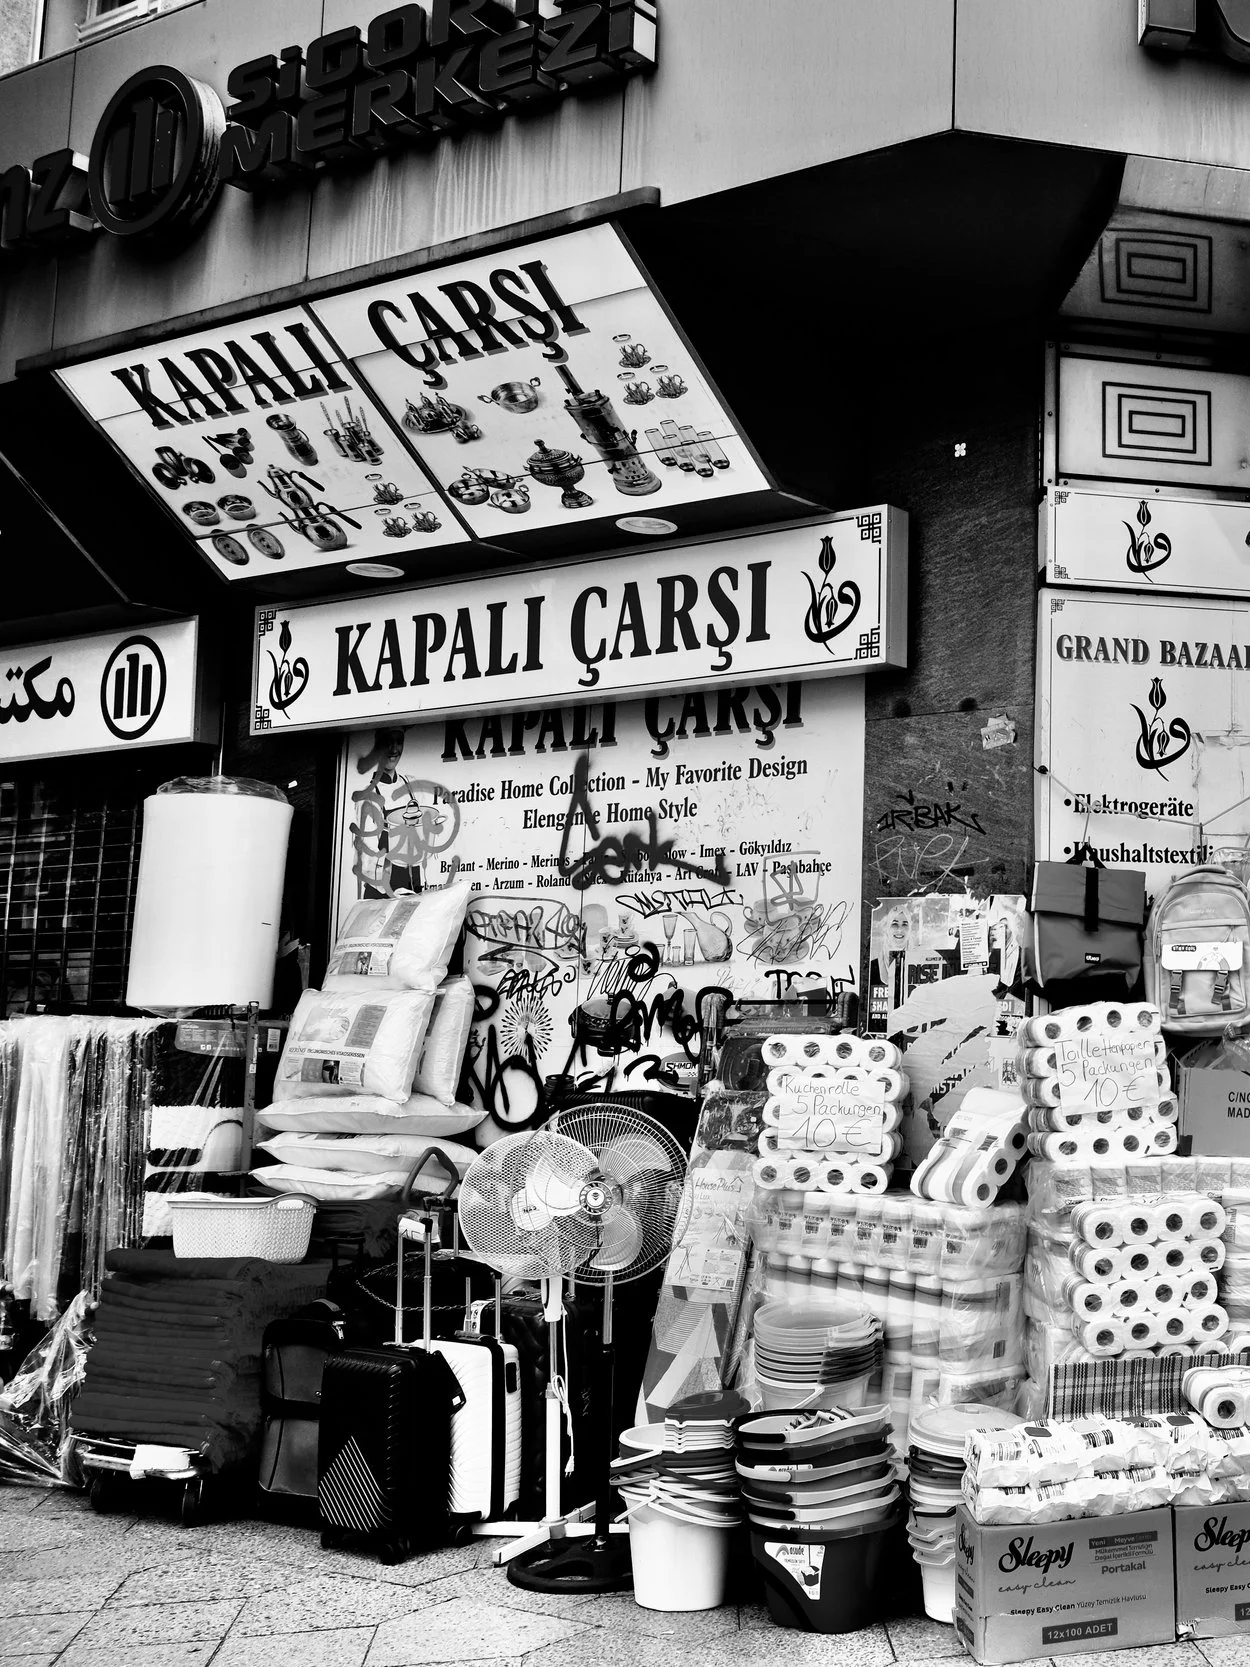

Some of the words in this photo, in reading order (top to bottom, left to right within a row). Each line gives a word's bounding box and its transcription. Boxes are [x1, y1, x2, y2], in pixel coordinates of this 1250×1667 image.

[112, 322, 352, 430] KAPALI
[367, 261, 592, 390] ÇARŞI
[333, 597, 543, 697] KAPALI
[570, 561, 772, 686] ÇARŞI
[1056, 634, 1150, 664] GRAND
[433, 783, 495, 806] Paradise
[500, 780, 544, 800] Home
[646, 767, 669, 790] My
[675, 761, 742, 785] Favorite
[748, 755, 808, 779] Design
[607, 803, 652, 823] Home
[658, 797, 698, 822] Style
[1073, 793, 1194, 817] Elektrogeräte
[486, 857, 520, 871] Merino
[531, 855, 570, 868] Merins
[700, 845, 727, 858] Imex
[492, 877, 524, 891] Arzum
[536, 874, 571, 888] Roland
[736, 862, 759, 877] LAV
[908, 963, 939, 984] RISE
[1060, 1061, 1077, 1087] 5
[1082, 1058, 1152, 1082] Packungen
[792, 1095, 808, 1115] 5
[813, 1095, 882, 1117] Packungen
[998, 1536, 1075, 1574] Sleepy
[1101, 1560, 1146, 1575] Portakal
[1205, 1585, 1229, 1594] Sleepy
[1230, 1583, 1246, 1592] Easy
[1036, 1605, 1053, 1615] Easy
[1055, 1603, 1076, 1612] Clean
[1047, 1627, 1083, 1641] 12x100
[1085, 1622, 1114, 1635] ADET
